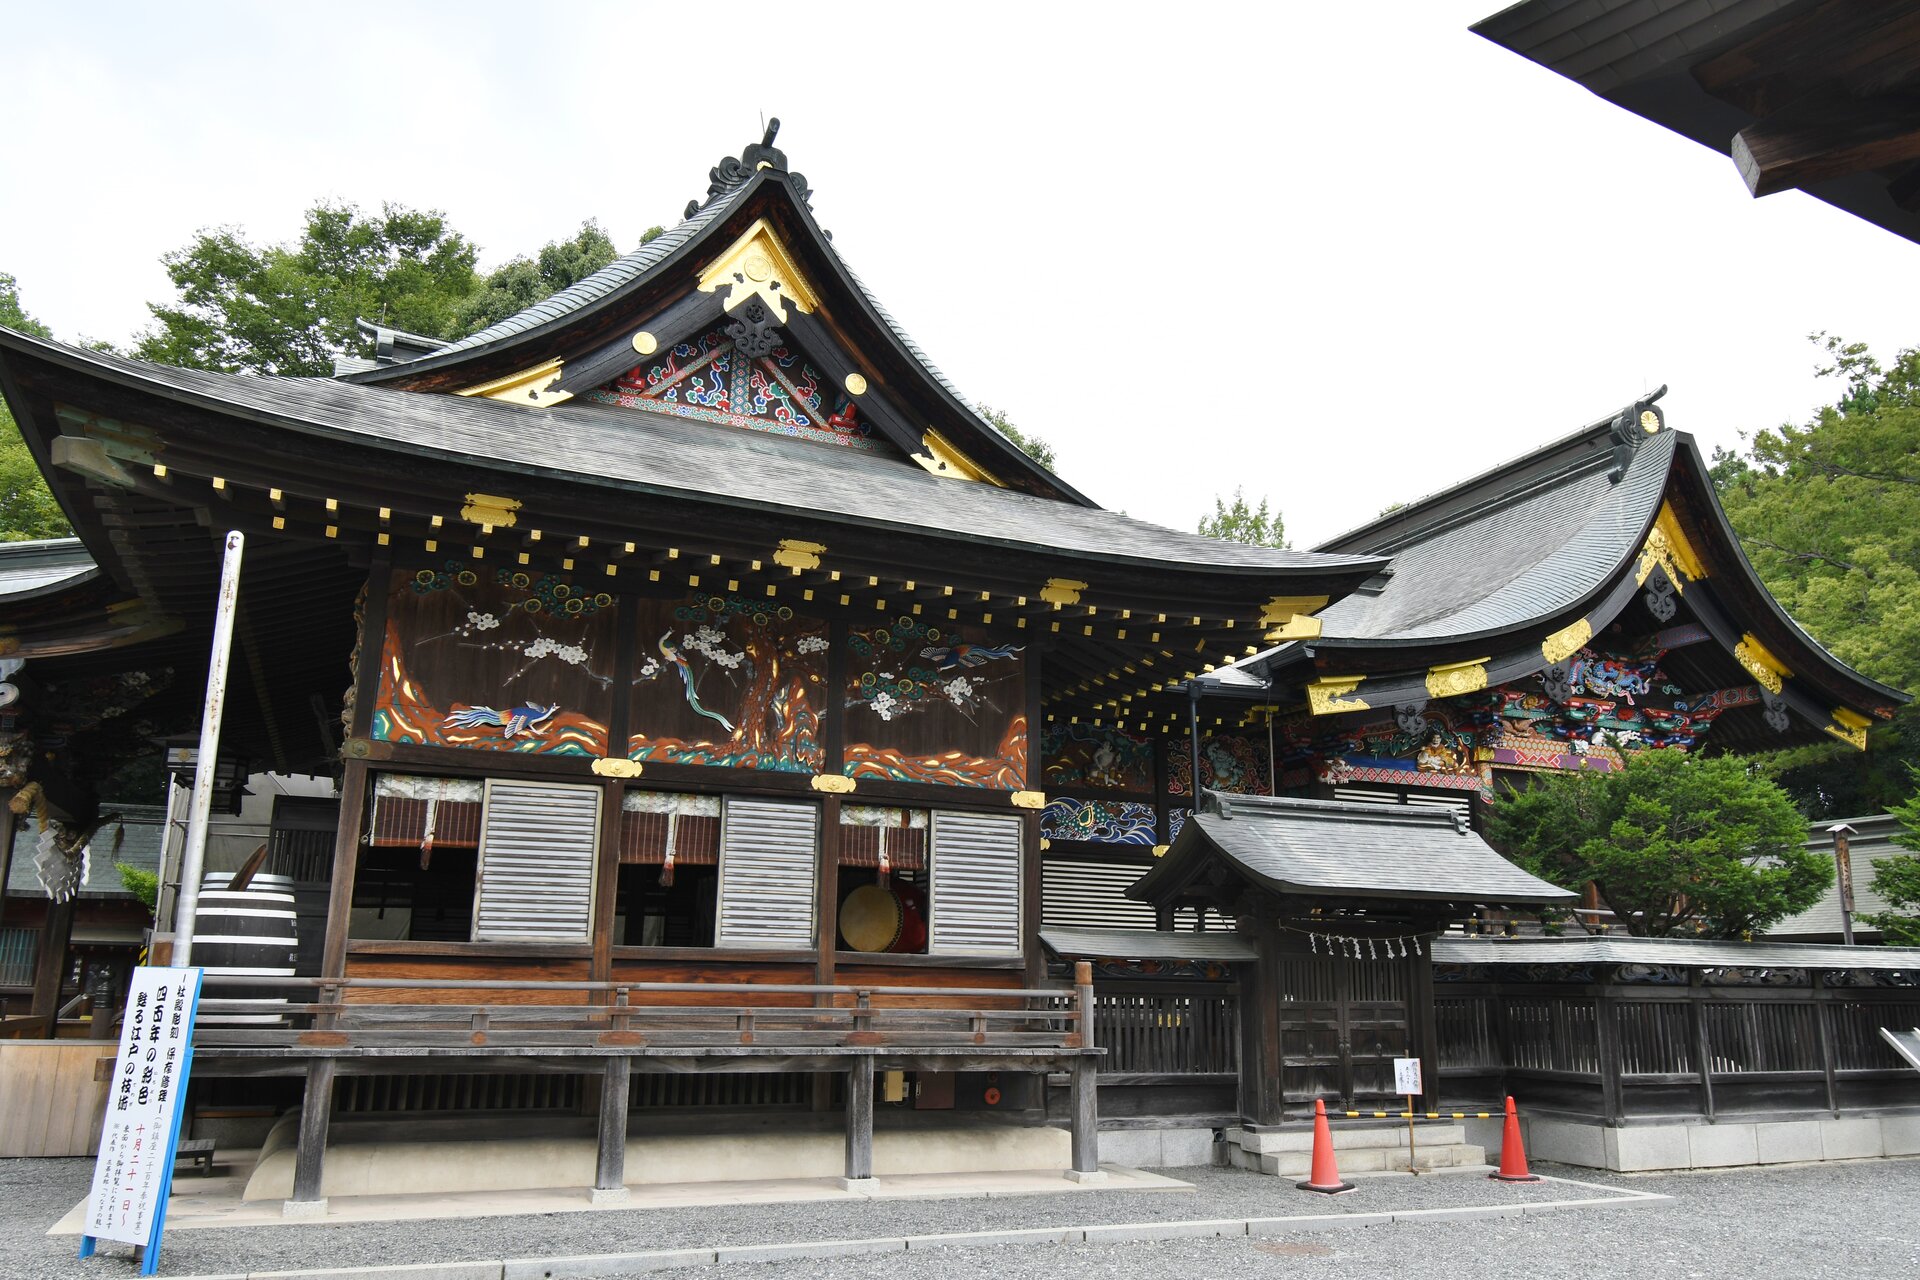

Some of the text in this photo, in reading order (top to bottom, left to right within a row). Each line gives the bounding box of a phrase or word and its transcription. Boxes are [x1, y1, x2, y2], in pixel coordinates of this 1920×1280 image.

[117, 991, 148, 1111] 甦る江戸の技術
[138, 985, 168, 1105] 四百年の彩色
